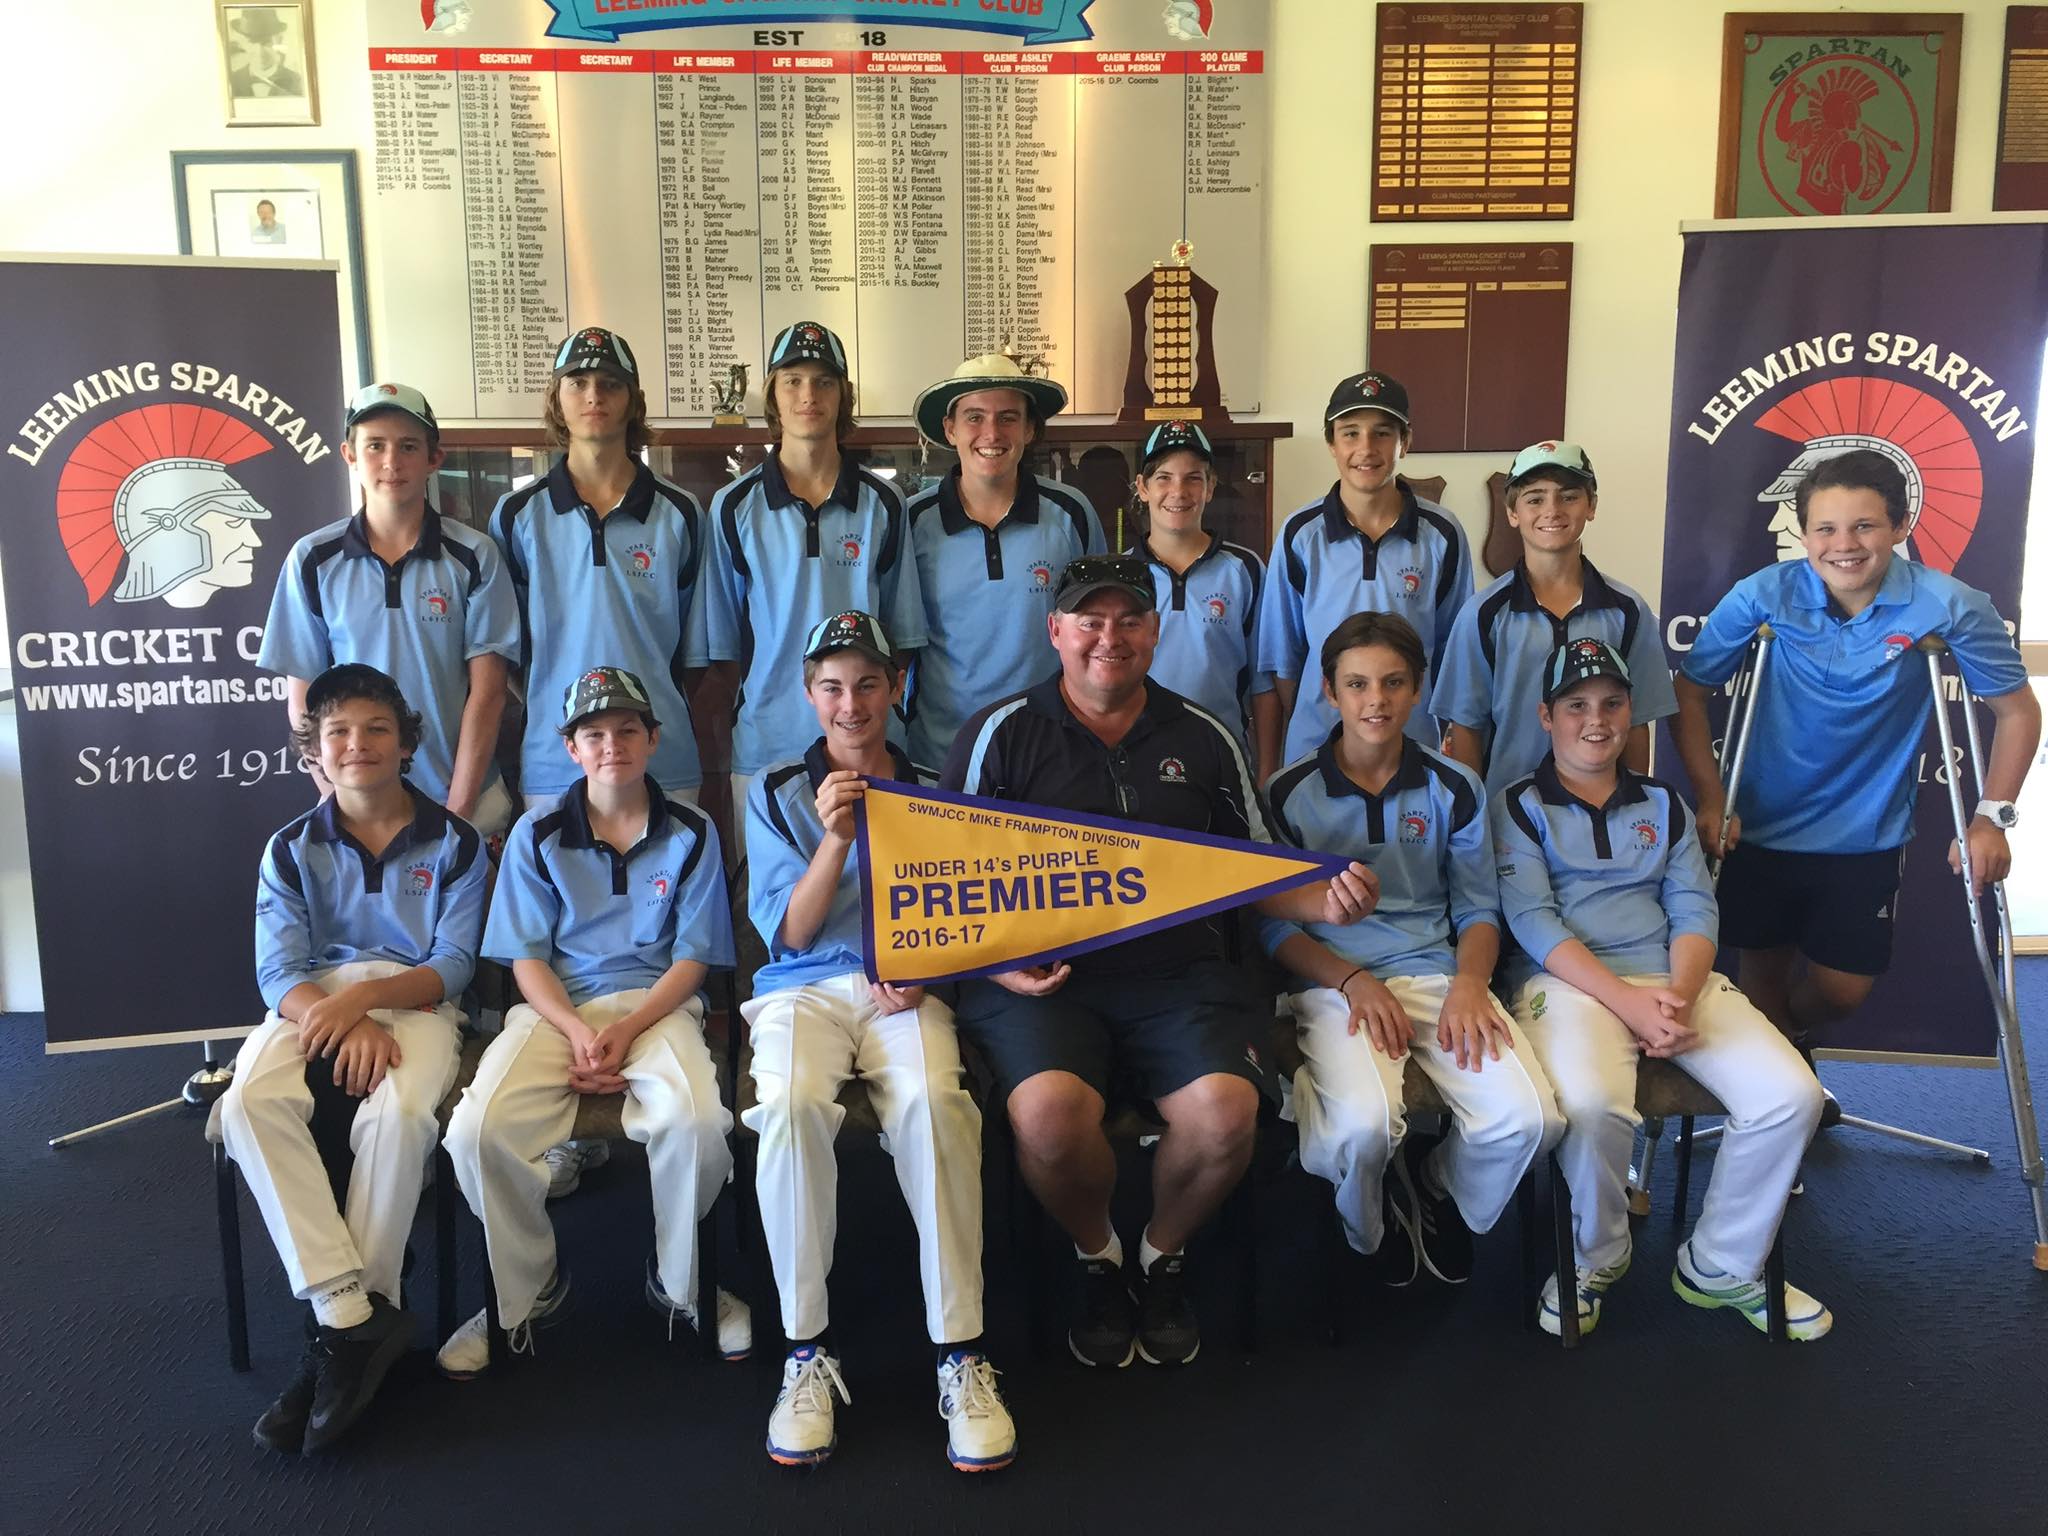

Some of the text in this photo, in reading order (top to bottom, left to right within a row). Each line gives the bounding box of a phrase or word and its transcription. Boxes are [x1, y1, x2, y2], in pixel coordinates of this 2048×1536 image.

[754, 31, 804, 46] EST
[385, 54, 438, 64] PRESIDENT
[479, 54, 533, 64] SECRETARY
[580, 55, 633, 65] SECRETARY
[673, 57, 735, 67] LIFE MEMBER
[772, 57, 833, 67] LIFE MEMBER
[872, 53, 942, 62] READ/WATERER
[983, 54, 1053, 62] GRAEME ASHLEY
[1096, 53, 1166, 62] GRAEME ASHLEY
[1200, 53, 1247, 62] 300 GAME
[1769, 38, 1912, 87] SPARTAN
[867, 64, 947, 72] CLUB CHAMPION MEDAL
[990, 65, 1048, 73] CLUB PERSON
[1103, 64, 1161, 72] CLUB PERSON
[1207, 64, 1241, 72] PLAYER
[911, 131, 936, 140] Dudley
[693, 202, 716, 210] Harry
[719, 202, 746, 210] Wortley
[704, 212, 732, 220] Spencer
[704, 238, 727, 246] James
[911, 279, 939, 287] Buckley
[1688, 332, 2028, 445] LEEMING SPARTAN
[7, 362, 331, 467] LEEMING SPARTAN
[16, 627, 223, 669] CRICKET
[21, 674, 289, 714] www.spartans.co
[74, 745, 198, 786] Since
[907, 801, 1141, 850] SWMJCC MIKE FRAMPTON DIVISION
[894, 849, 1099, 880] UNDER 14's PURPLE
[888, 866, 1147, 921] PREMIERS
[890, 924, 986, 950] 2016-17
